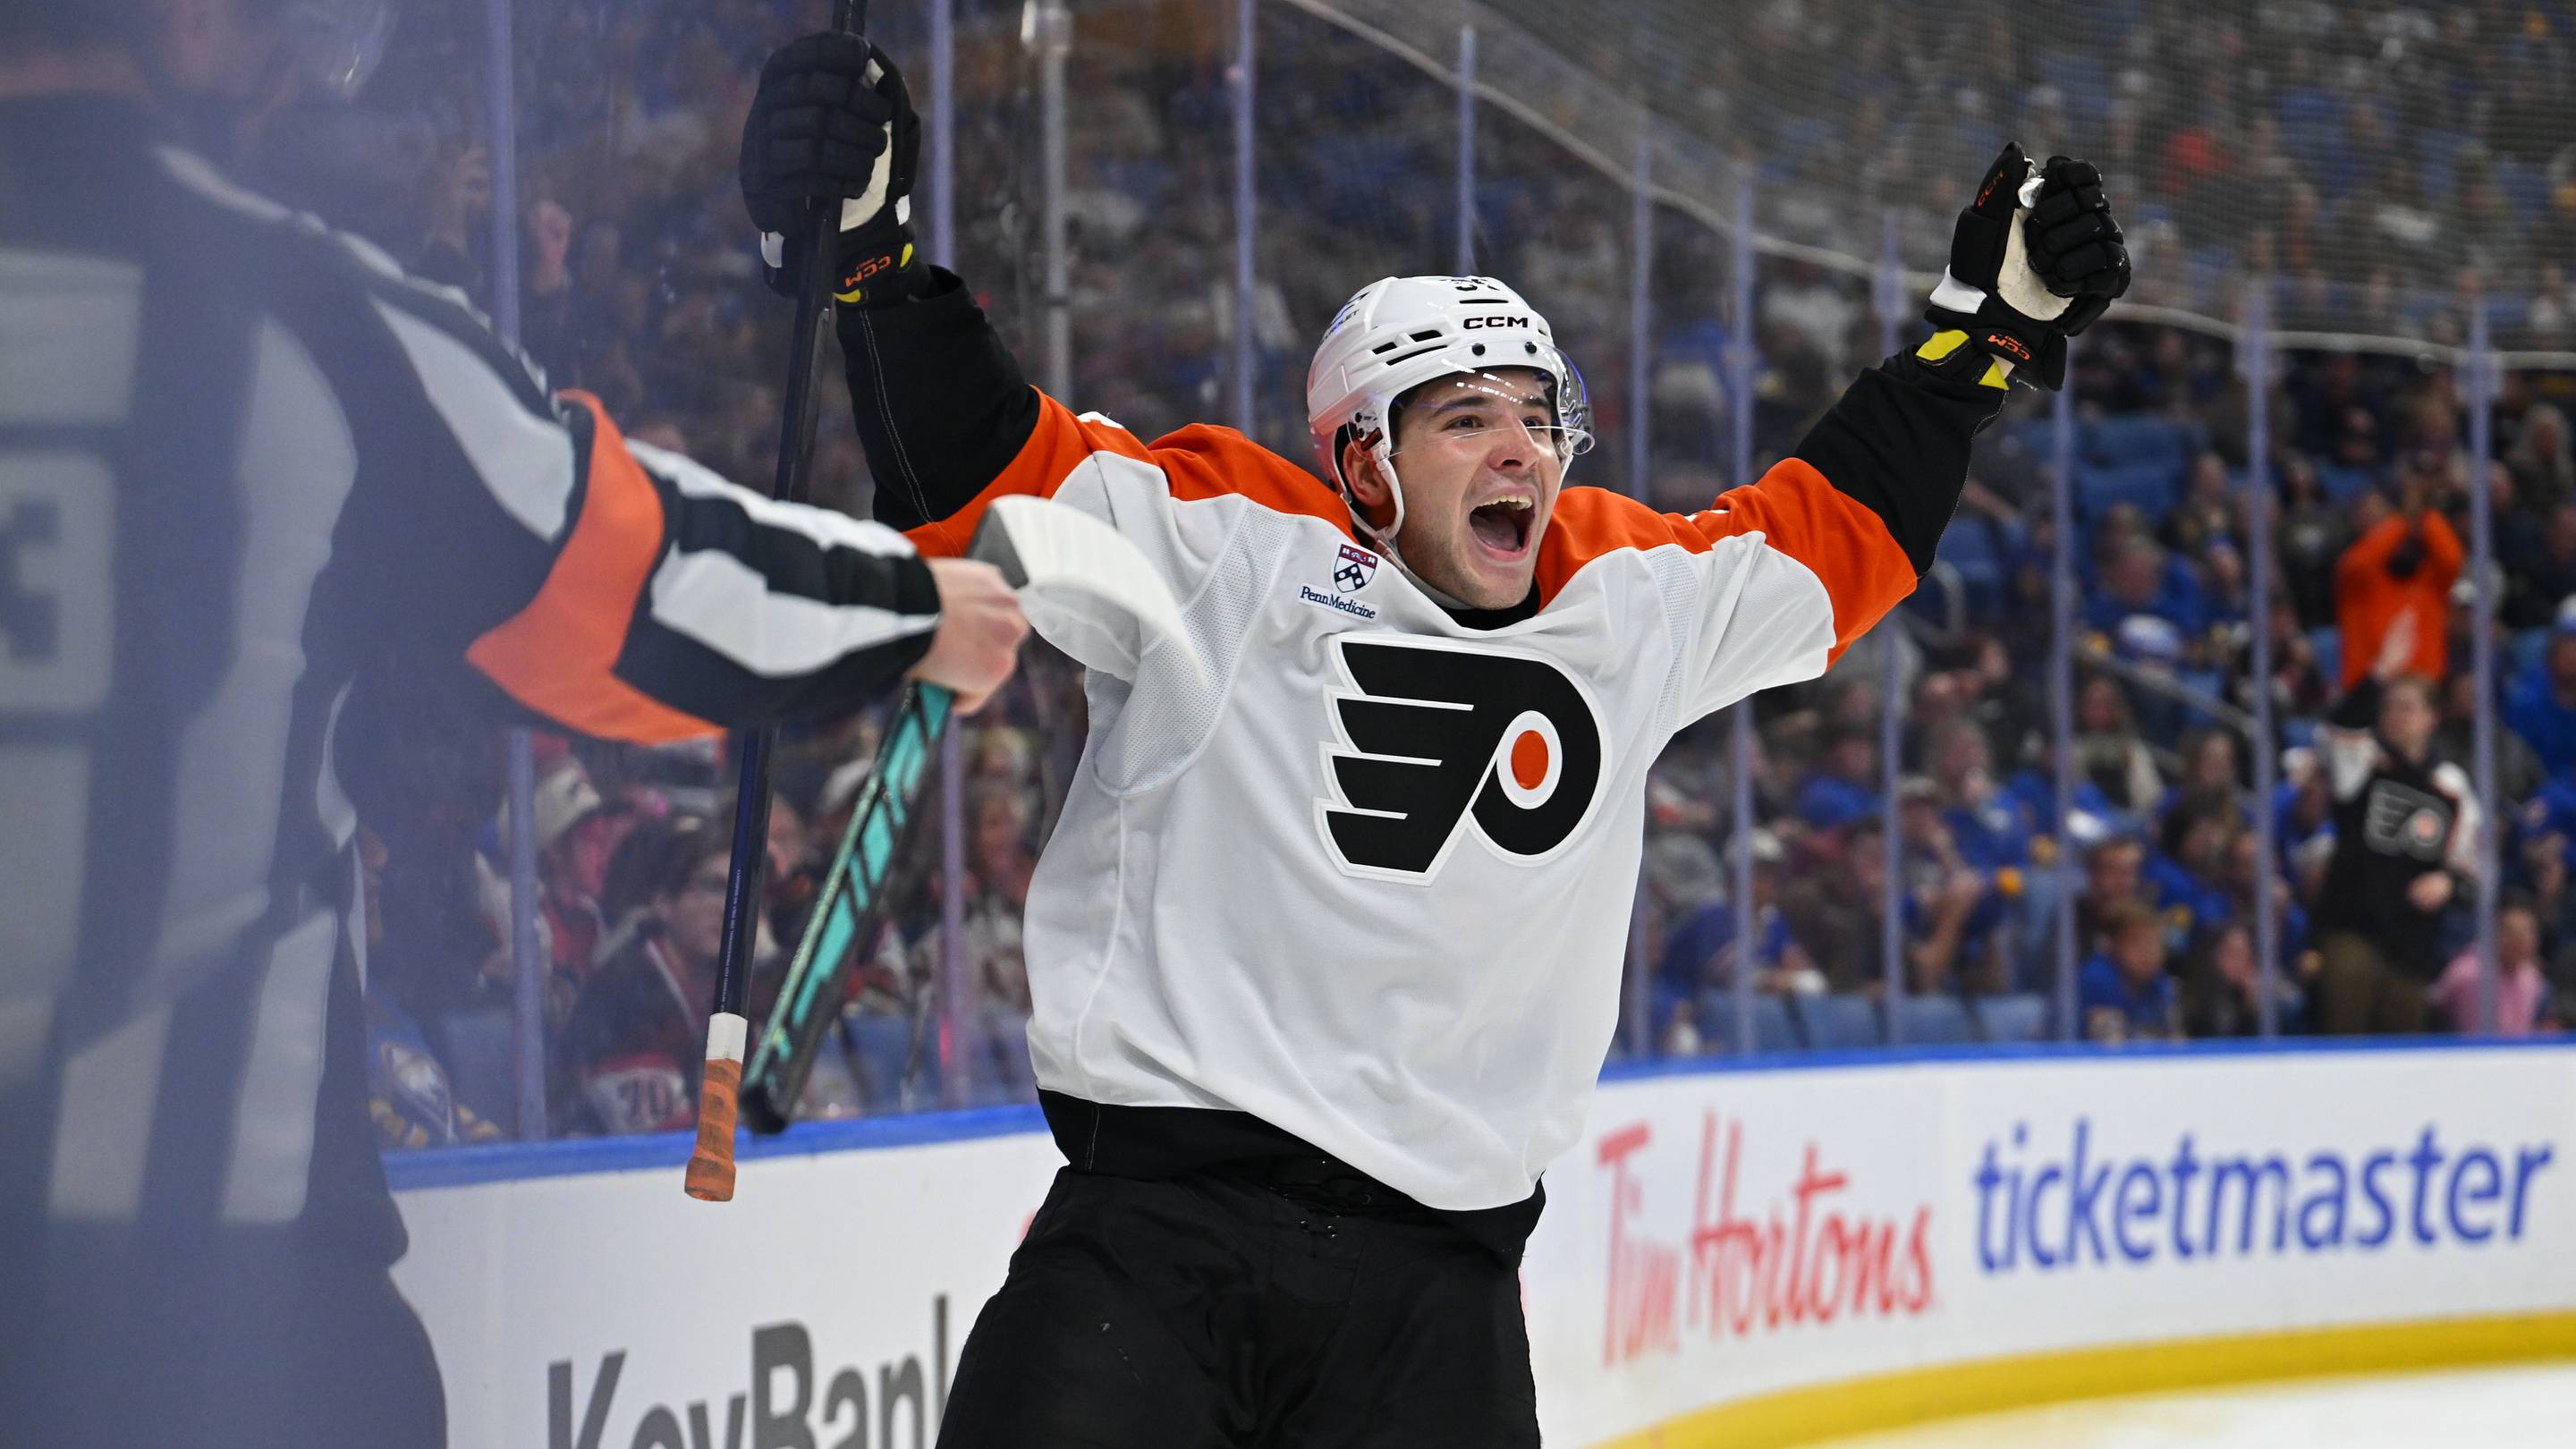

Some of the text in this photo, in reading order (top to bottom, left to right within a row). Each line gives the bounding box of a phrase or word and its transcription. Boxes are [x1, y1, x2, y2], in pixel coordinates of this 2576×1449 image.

[844, 256, 891, 287] CCM
[1462, 316, 1529, 330] CCM
[1987, 335, 2030, 360] CCM
[1597, 1107, 1936, 1367] Tim Hortons
[1975, 1118, 2555, 1270] ticketmaster
[547, 1292, 948, 1449] KBan
